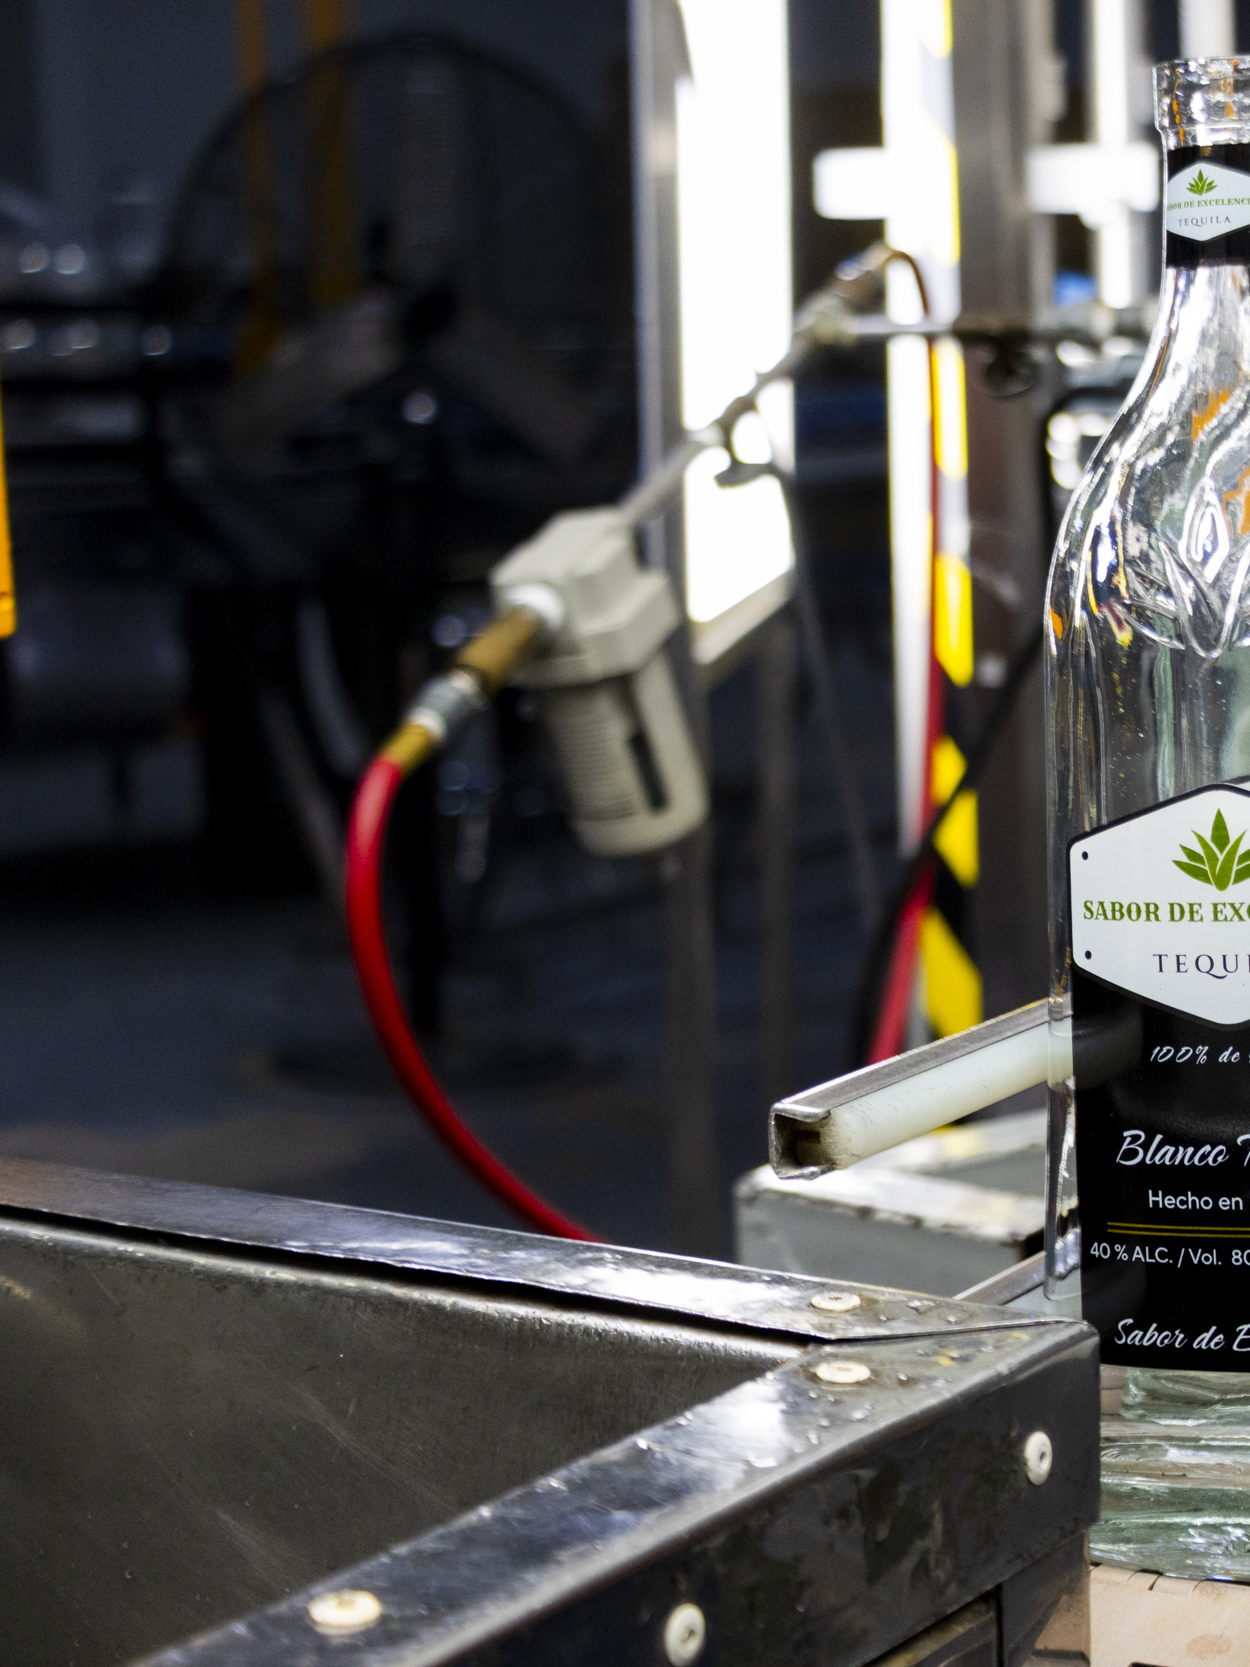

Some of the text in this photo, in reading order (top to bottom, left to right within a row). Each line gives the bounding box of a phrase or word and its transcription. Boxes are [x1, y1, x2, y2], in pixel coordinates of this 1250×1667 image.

[1184, 200, 1195, 209] DE
[1178, 216, 1231, 227] TEQUILA
[1083, 900, 1161, 922] SABOR
[1168, 902, 1203, 922] DE
[1150, 1045, 1208, 1065] 100%
[1218, 1046, 1241, 1063] de
[1116, 1129, 1230, 1167] Blanco
[1148, 1190, 1213, 1210] Hecho
[1218, 1195, 1243, 1211] en
[1114, 1318, 1188, 1348] Sabor
[1192, 1325, 1226, 1350] de
